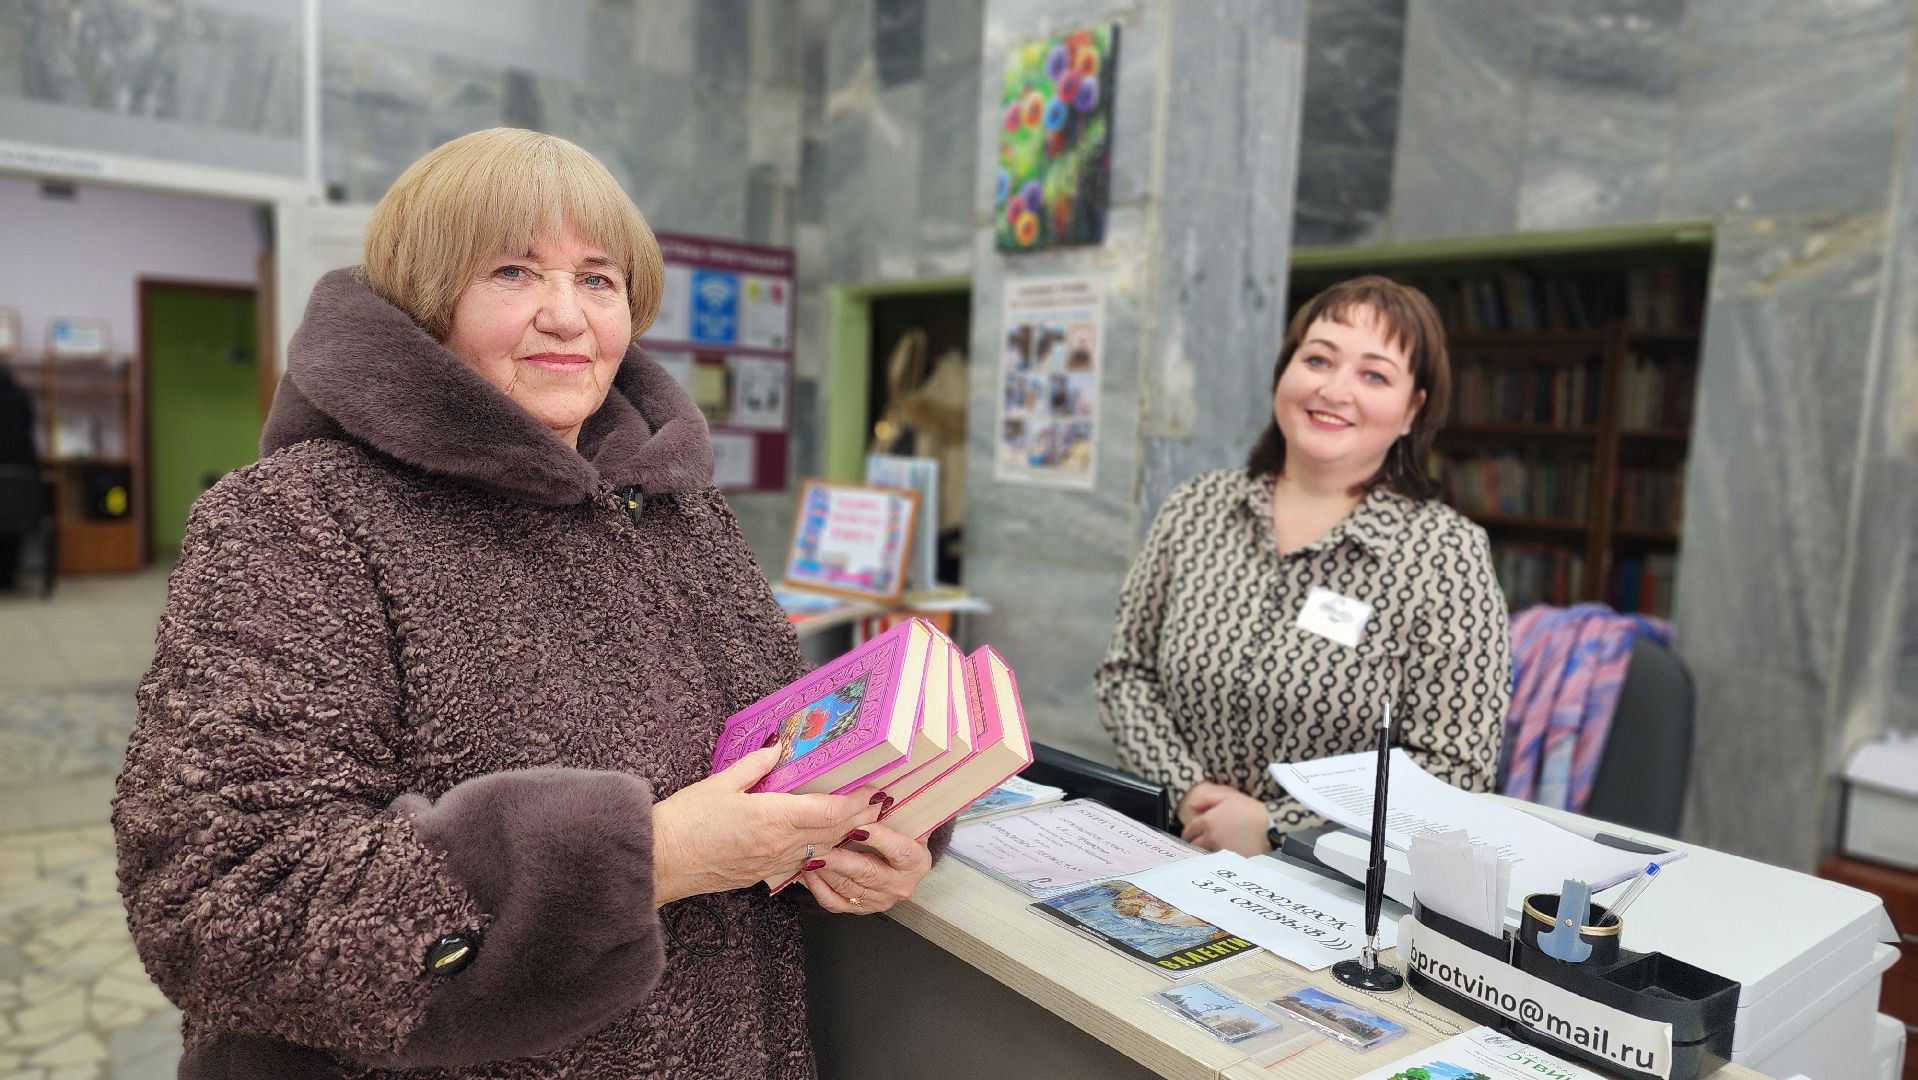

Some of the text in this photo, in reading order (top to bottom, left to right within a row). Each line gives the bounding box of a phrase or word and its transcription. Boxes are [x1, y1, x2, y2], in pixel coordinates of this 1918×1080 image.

[1192, 879, 1228, 894] ЗА
[1230, 897, 1327, 937] ОТЗЫВ
[1216, 869, 1357, 932] В ПОДАРОК
[1409, 939, 1655, 1070] bprotvino@mail.ru
